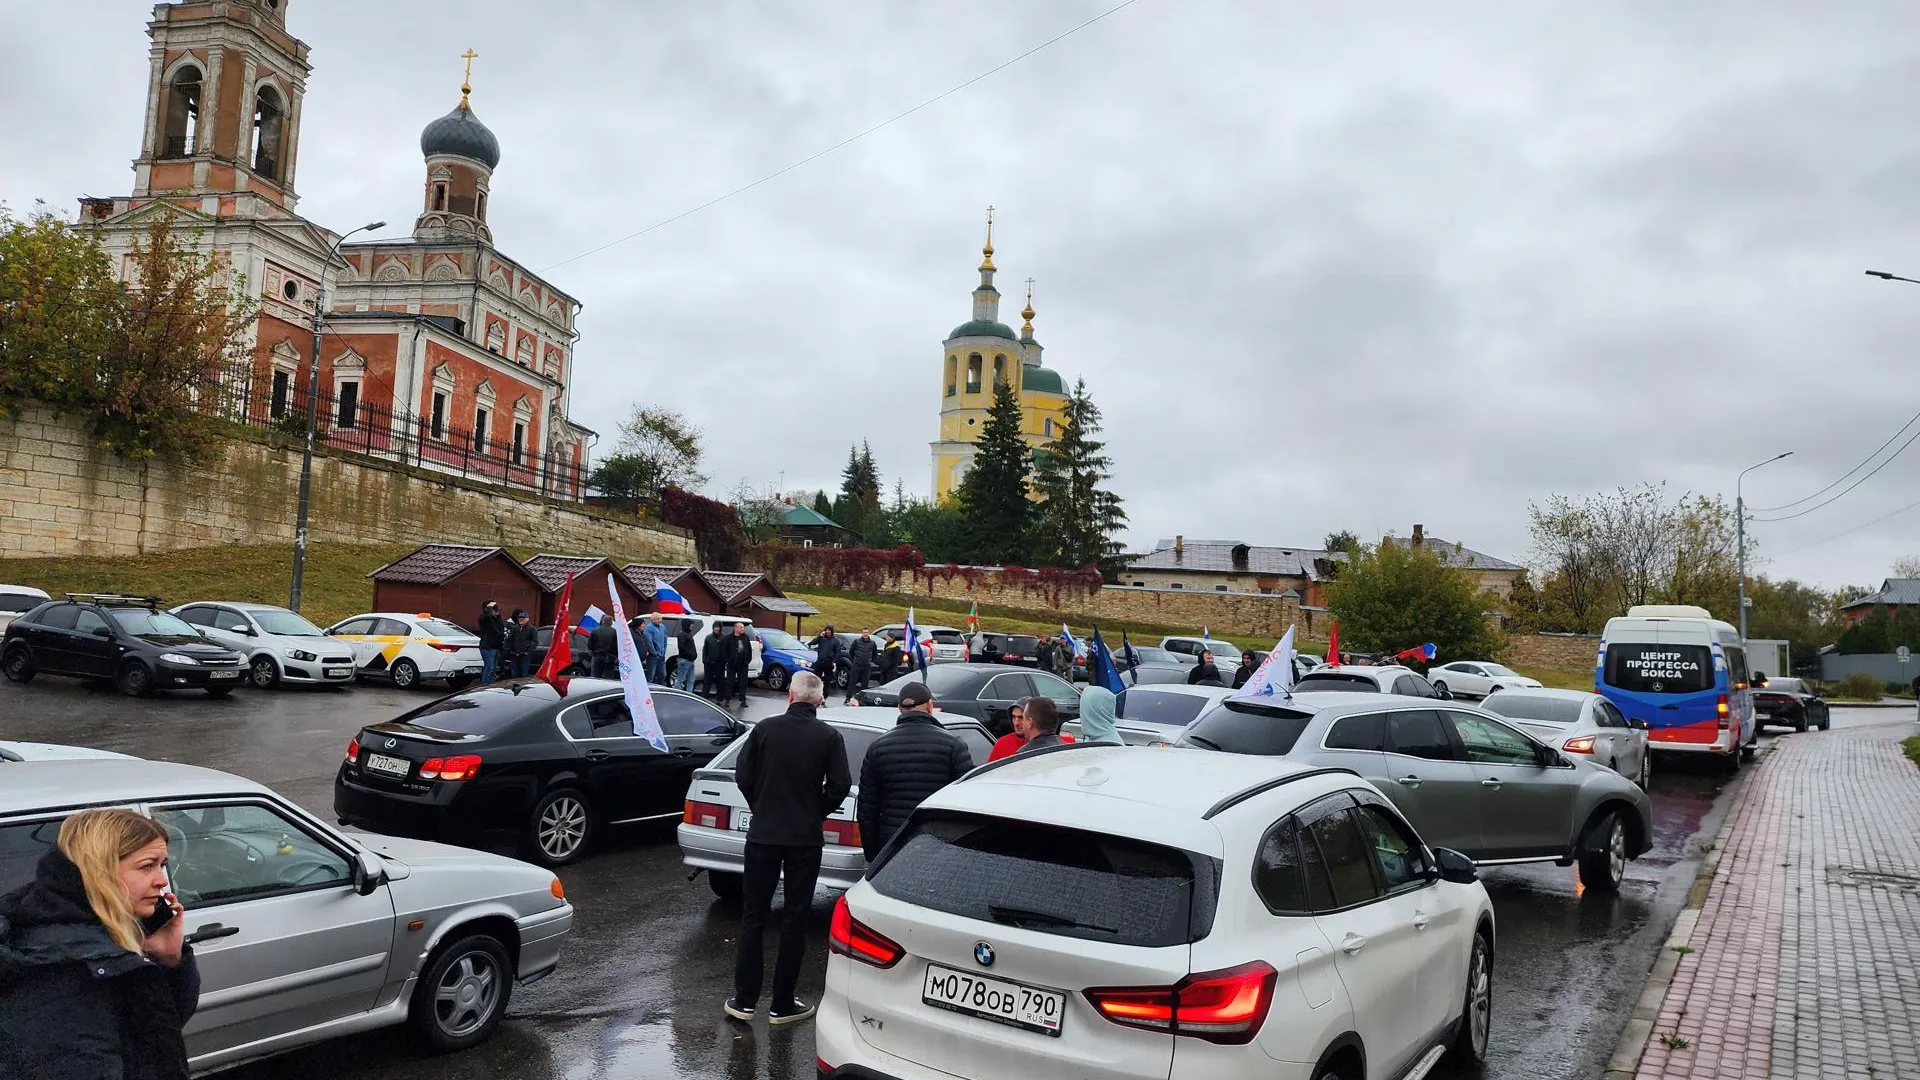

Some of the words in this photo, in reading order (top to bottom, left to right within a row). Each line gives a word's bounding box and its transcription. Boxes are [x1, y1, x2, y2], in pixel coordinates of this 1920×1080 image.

[1640, 652, 1681, 661] ЦЕНТР
[1626, 660, 1699, 670] ПРОГРЕССА
[1641, 669, 1682, 679] БОКСА
[1021, 990, 1056, 1016] 790
[1026, 1012, 1044, 1023] RUS
